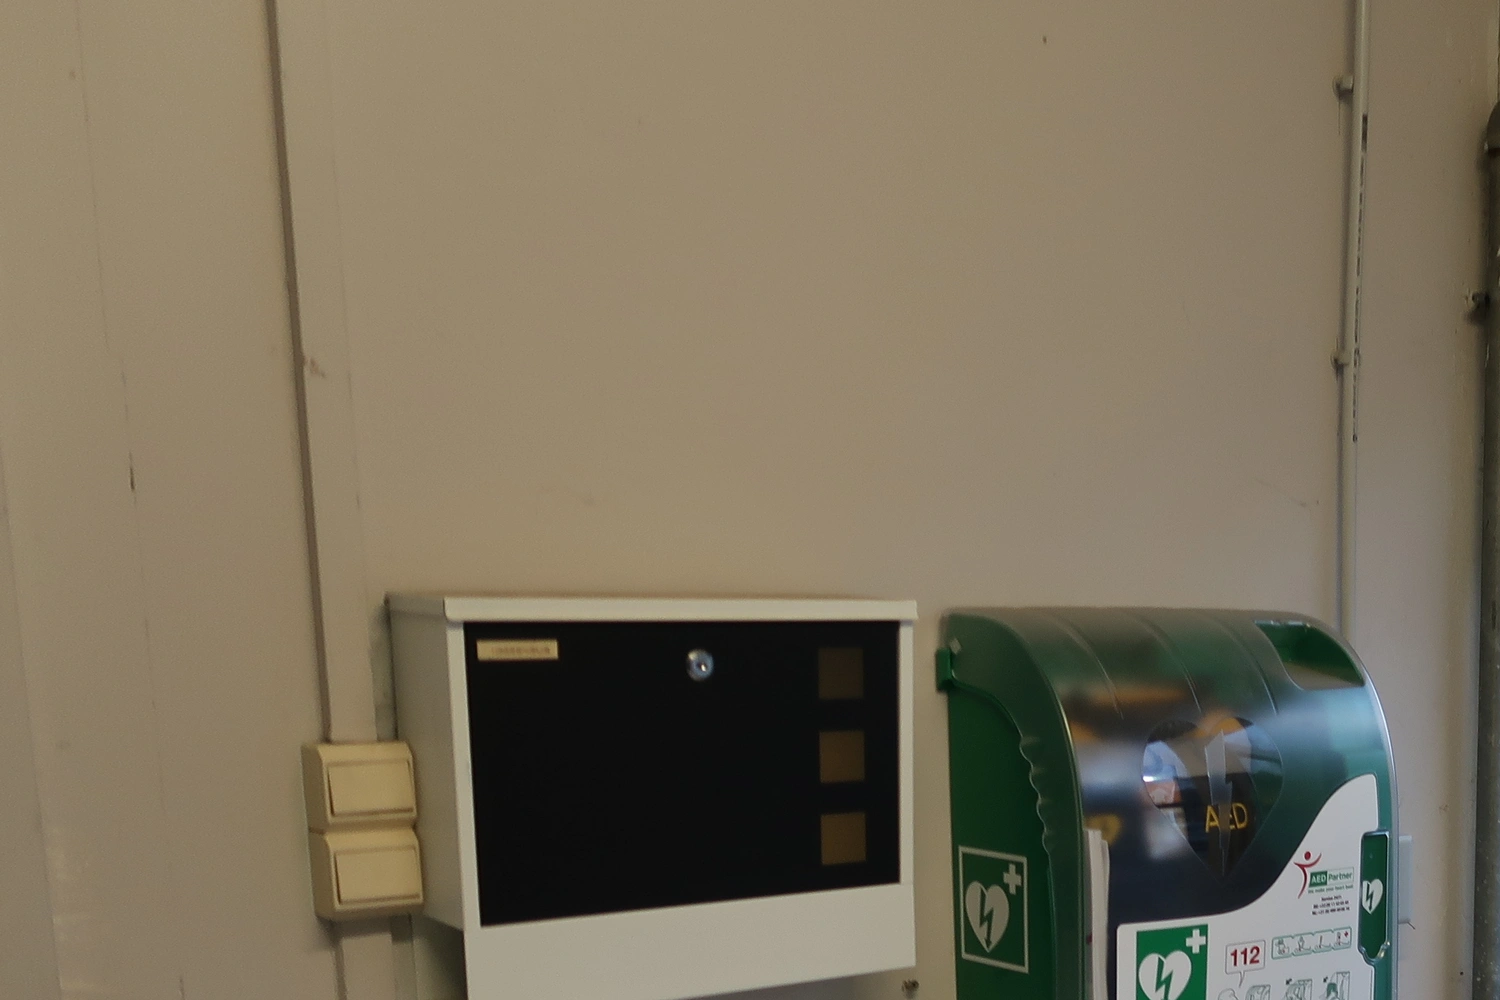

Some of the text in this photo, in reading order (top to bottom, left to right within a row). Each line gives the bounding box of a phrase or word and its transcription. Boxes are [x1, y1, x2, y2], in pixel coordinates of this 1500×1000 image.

[1205, 802, 1248, 833] AD
[1311, 872, 1352, 884] AED Partner
[1230, 945, 1260, 967] 112
